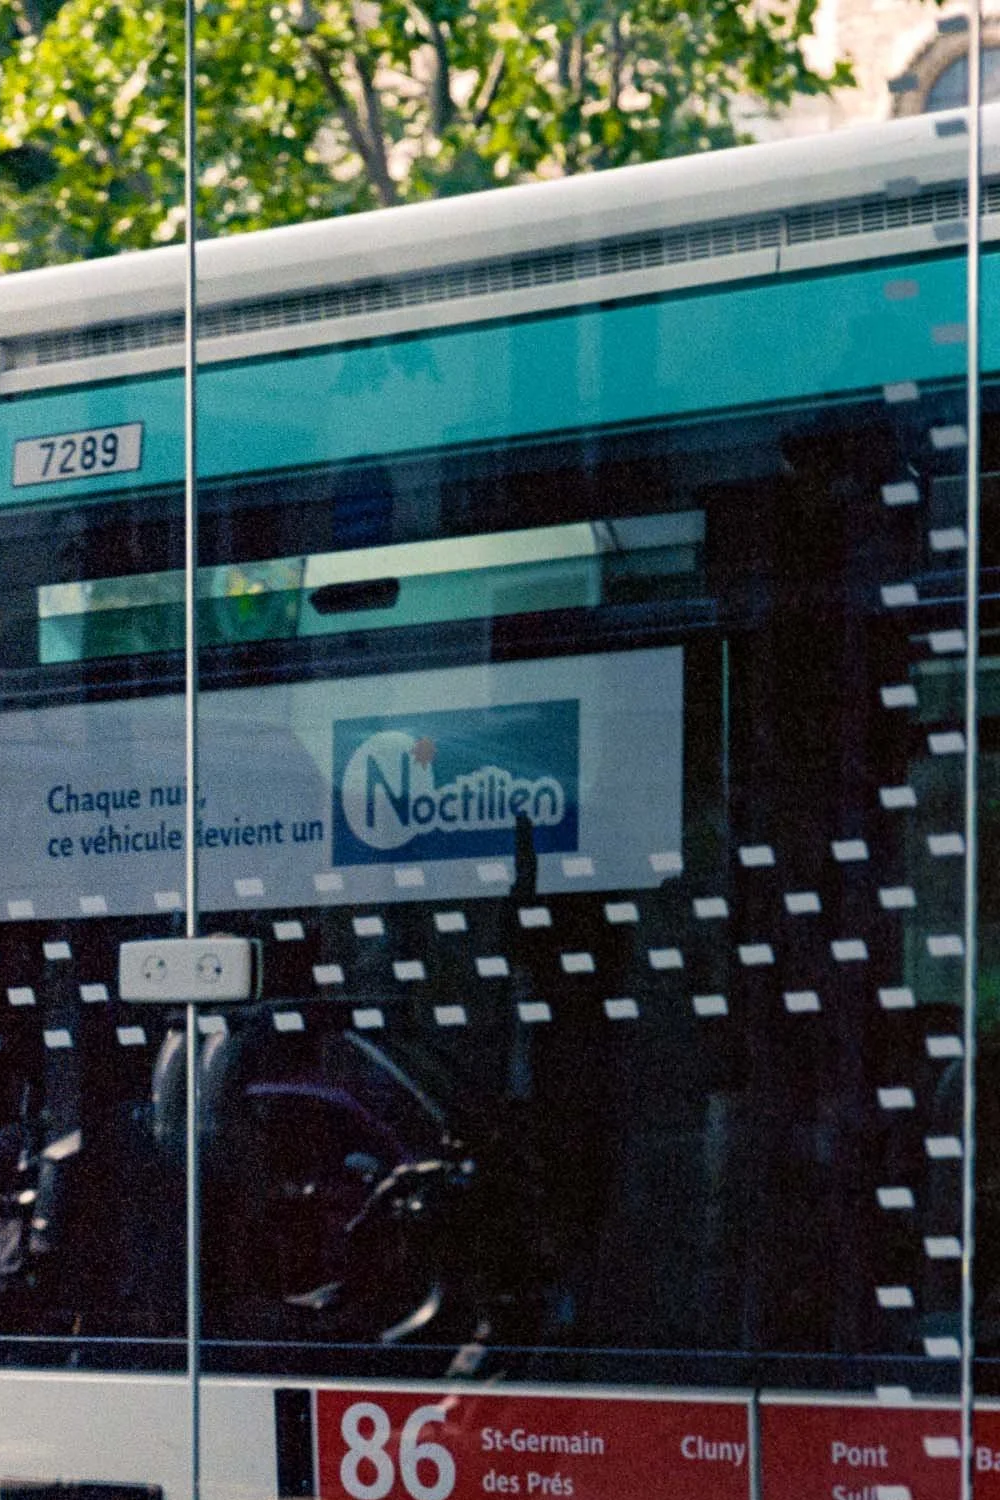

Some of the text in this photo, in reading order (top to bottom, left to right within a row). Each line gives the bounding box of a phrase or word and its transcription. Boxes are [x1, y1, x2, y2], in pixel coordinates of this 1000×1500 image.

[40, 432, 119, 476] 7289
[49, 784, 206, 818] Chaque nu,
[365, 750, 558, 829] Noctilien
[49, 837, 74, 857] ce
[81, 821, 182, 855] véhicule
[293, 818, 324, 843] un
[481, 1428, 604, 1455] St-Germain
[680, 1435, 746, 1466] Cluny
[831, 1441, 888, 1467] Pont
[482, 1470, 574, 1496] des Prés
